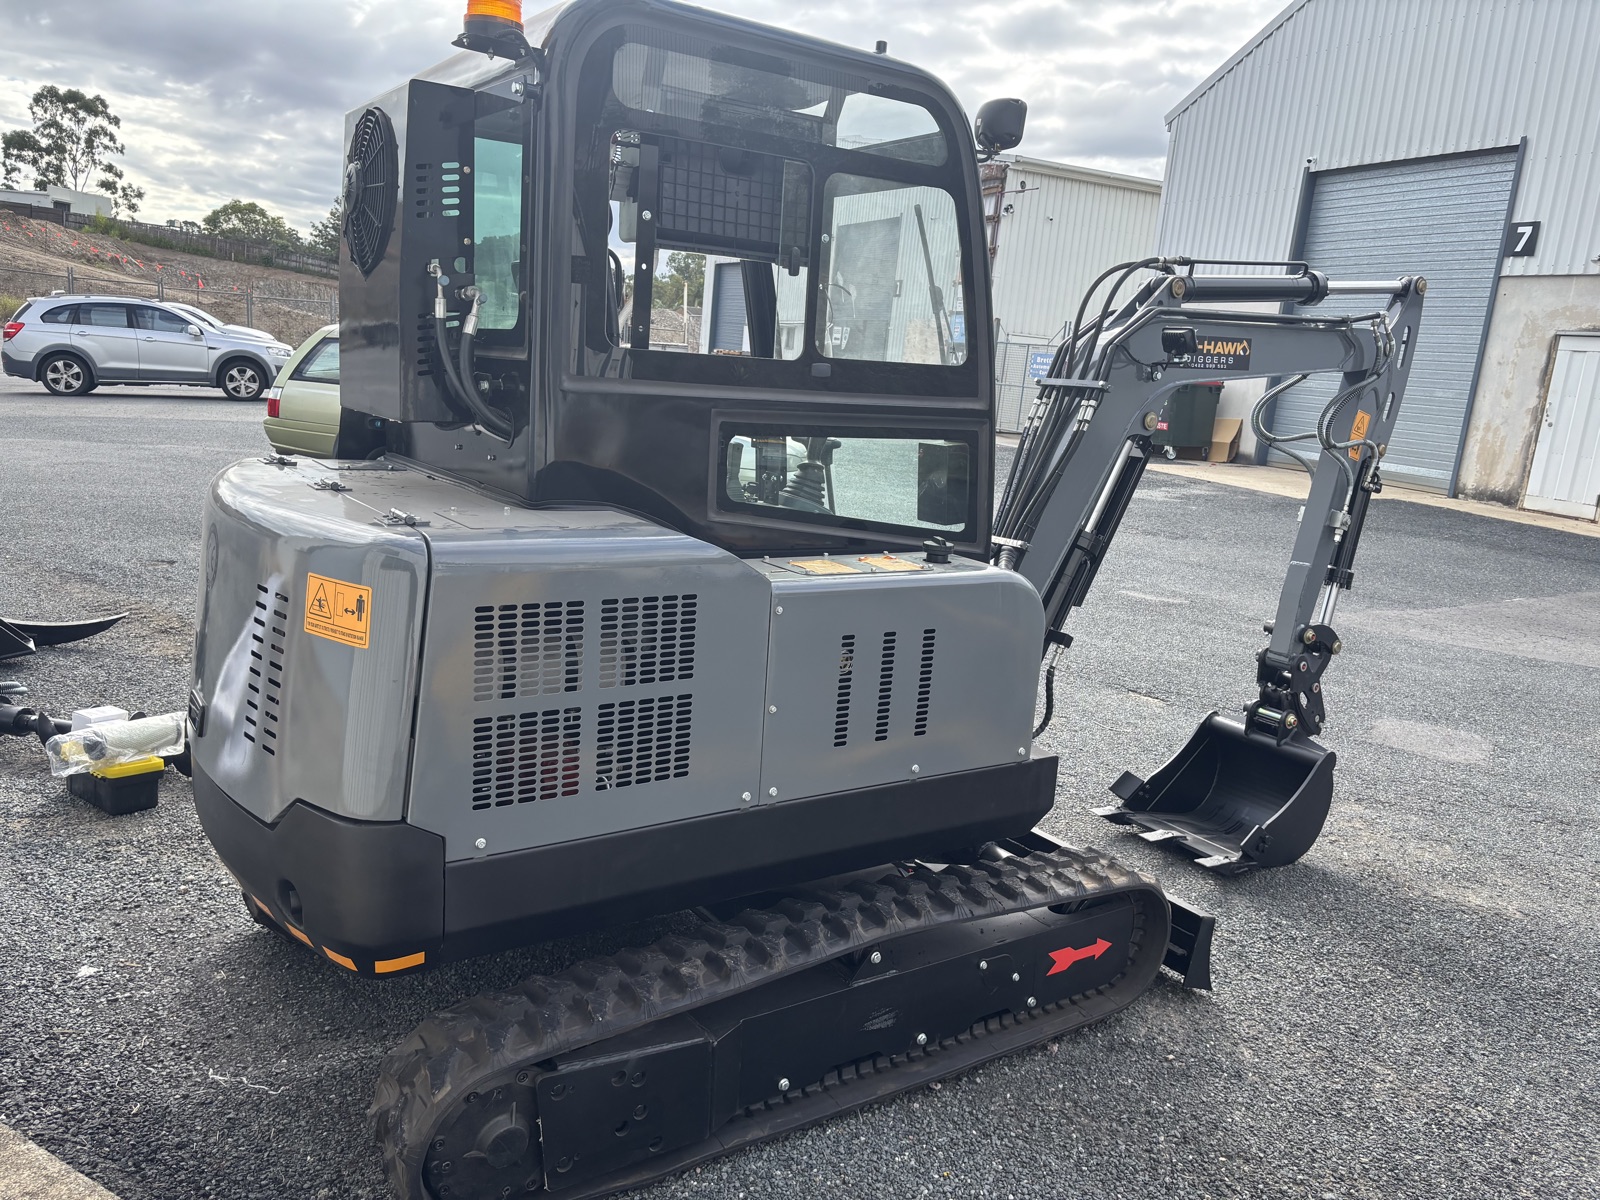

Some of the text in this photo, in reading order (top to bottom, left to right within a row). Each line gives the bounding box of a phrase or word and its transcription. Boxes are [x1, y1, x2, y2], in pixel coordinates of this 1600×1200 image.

[1514, 226, 1533, 252] 7
[1197, 340, 1249, 355] -HAWK
[1186, 356, 1234, 364] DIGGERS
